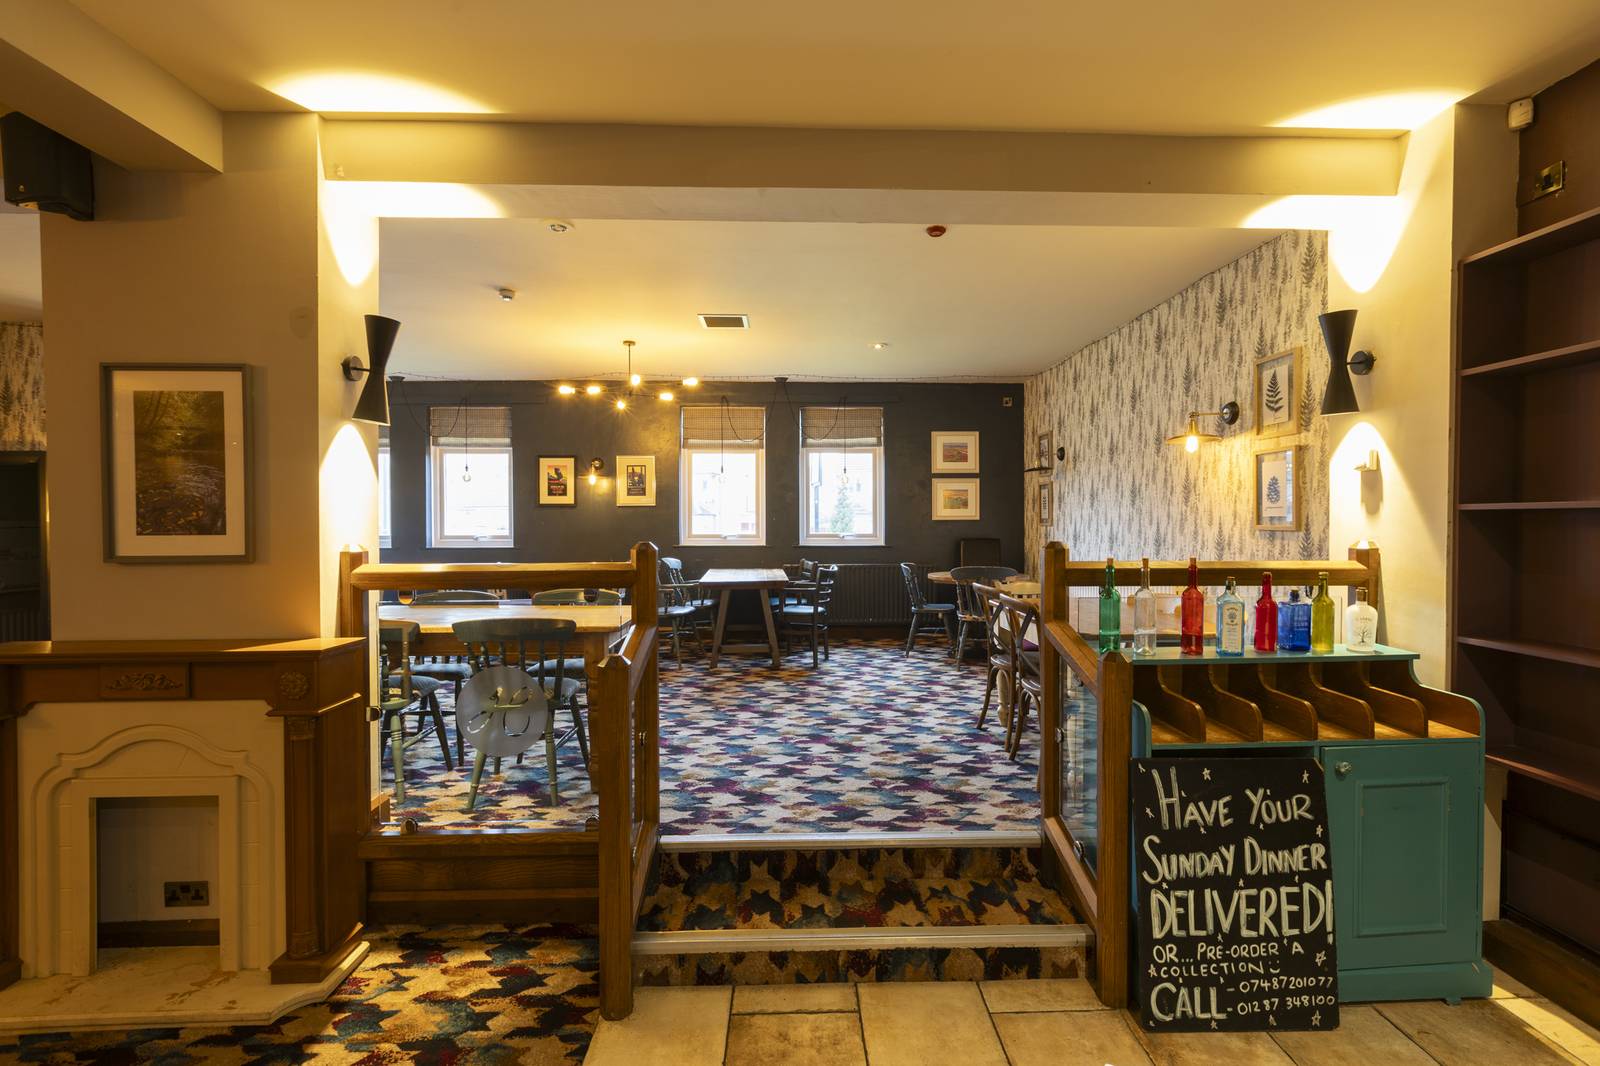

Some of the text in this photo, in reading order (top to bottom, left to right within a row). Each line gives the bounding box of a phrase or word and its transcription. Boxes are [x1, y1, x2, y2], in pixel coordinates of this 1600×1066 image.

[1152, 766, 1315, 830] HAVE YOUR
[1142, 835, 1327, 884] SUNDAY DINNER
[1151, 880, 1334, 945] DELIVERED!
[1160, 961, 1265, 978] COLLECTION
[1197, 942, 1279, 961] PRE-ORDER
[1292, 941, 1304, 955] A
[1150, 982, 1227, 1021] CALL
